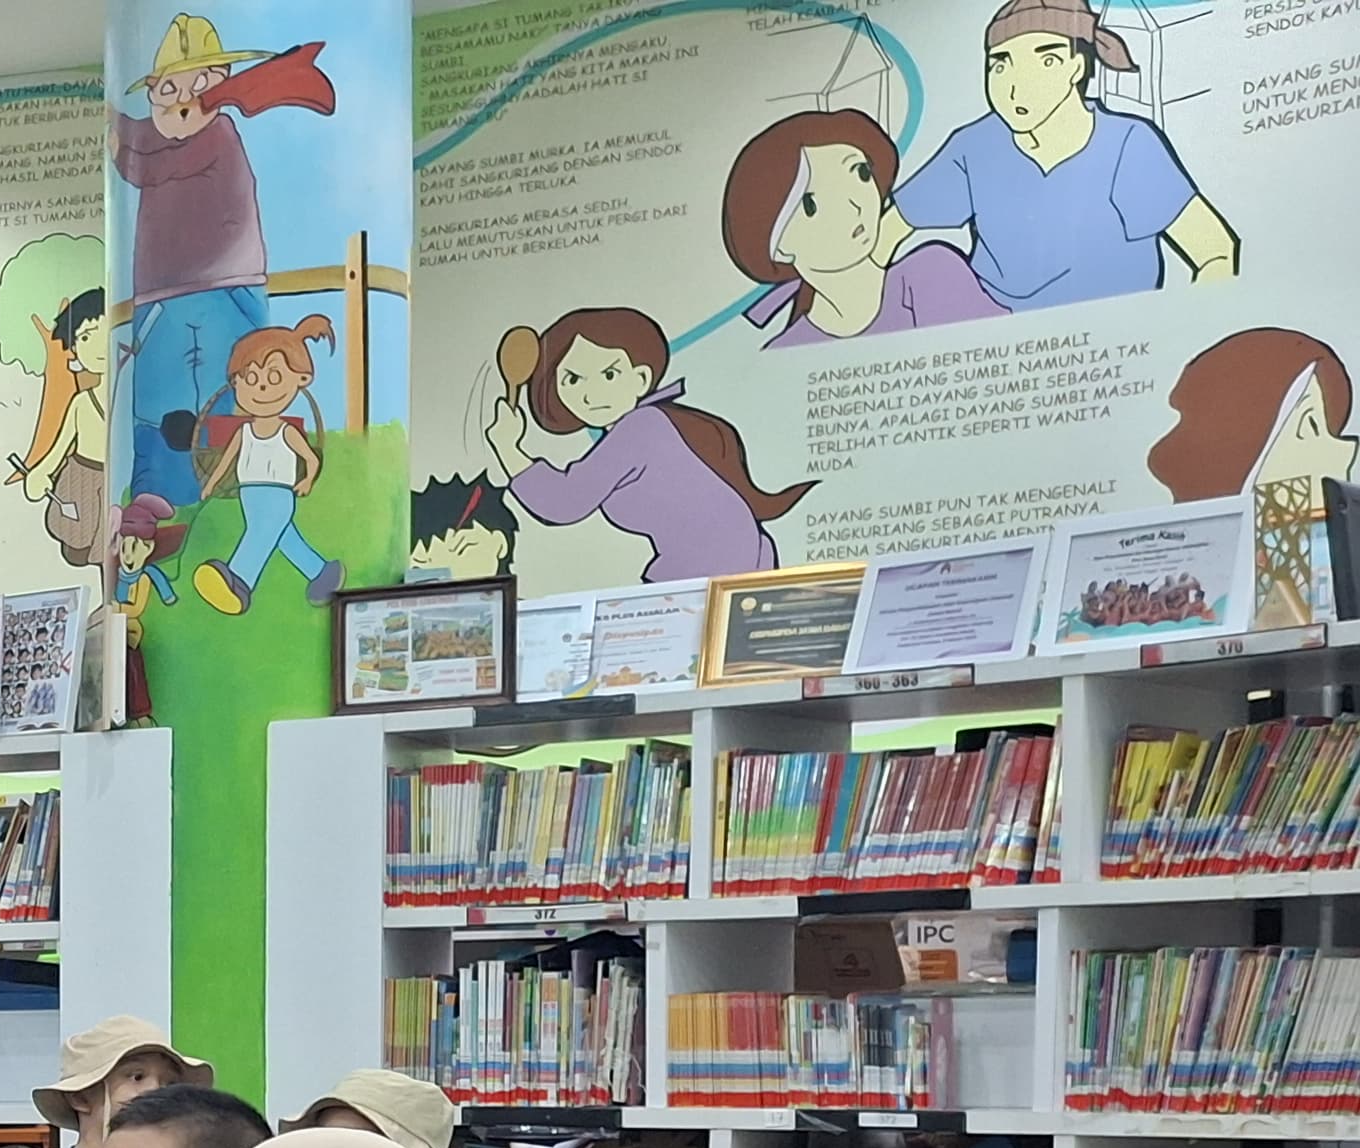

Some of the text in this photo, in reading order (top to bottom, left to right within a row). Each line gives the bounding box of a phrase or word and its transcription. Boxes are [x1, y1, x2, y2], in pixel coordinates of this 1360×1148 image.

[1245, 10, 1315, 38] SENDOK
[539, 67, 578, 82] YANG
[581, 60, 614, 74] KITA
[619, 53, 671, 70] MAKAN
[675, 46, 700, 60] INI
[591, 70, 649, 91] HATI SI
[1243, 64, 1322, 94] DAYANG
[1242, 75, 1360, 114] UNTUK MEN
[38, 152, 86, 166] NAMUN
[72, 136, 97, 148] PUN
[420, 160, 476, 178] DAYANG
[480, 154, 524, 170] SUMBI
[584, 140, 600, 151] IA
[420, 180, 454, 194] DAHI
[460, 162, 558, 186] SANGKURIANG
[563, 153, 622, 172] DENGAN
[420, 192, 455, 208] KAYU
[458, 186, 512, 202] HINGGA
[14, 215, 28, 226] SI
[33, 209, 86, 224] TUMANG
[420, 214, 519, 239] SANGKURIANG
[522, 204, 578, 224] MERASA
[420, 203, 688, 252] LALU MEMUTUSKAN UNTUK PERGI DARI
[420, 252, 468, 268] RUMAH
[472, 246, 518, 261] UNTUK
[806, 342, 1150, 402] DENGAN DAYANG NAMUN IA TAK
[807, 332, 1091, 385] SANGKURIANG BERTEMU KEMBALI
[806, 365, 1122, 420] MENGENALI DAYANG SUMBI SEBAGAI
[880, 408, 949, 428] APALAGI
[956, 399, 1025, 419] DAYANG
[1030, 390, 1087, 410] SUMBI
[1093, 380, 1154, 401] MASIH
[806, 406, 1111, 456] TERLIHAT CANTIK SEPERTI WANITA
[806, 479, 1117, 527] DAYANG SUMBI PUN TAK MENGENALI
[806, 520, 926, 545] SANGKURIANG
[931, 510, 1004, 532] SEBAGAI
[806, 543, 870, 562] KARENA
[916, 925, 955, 943] IPC
